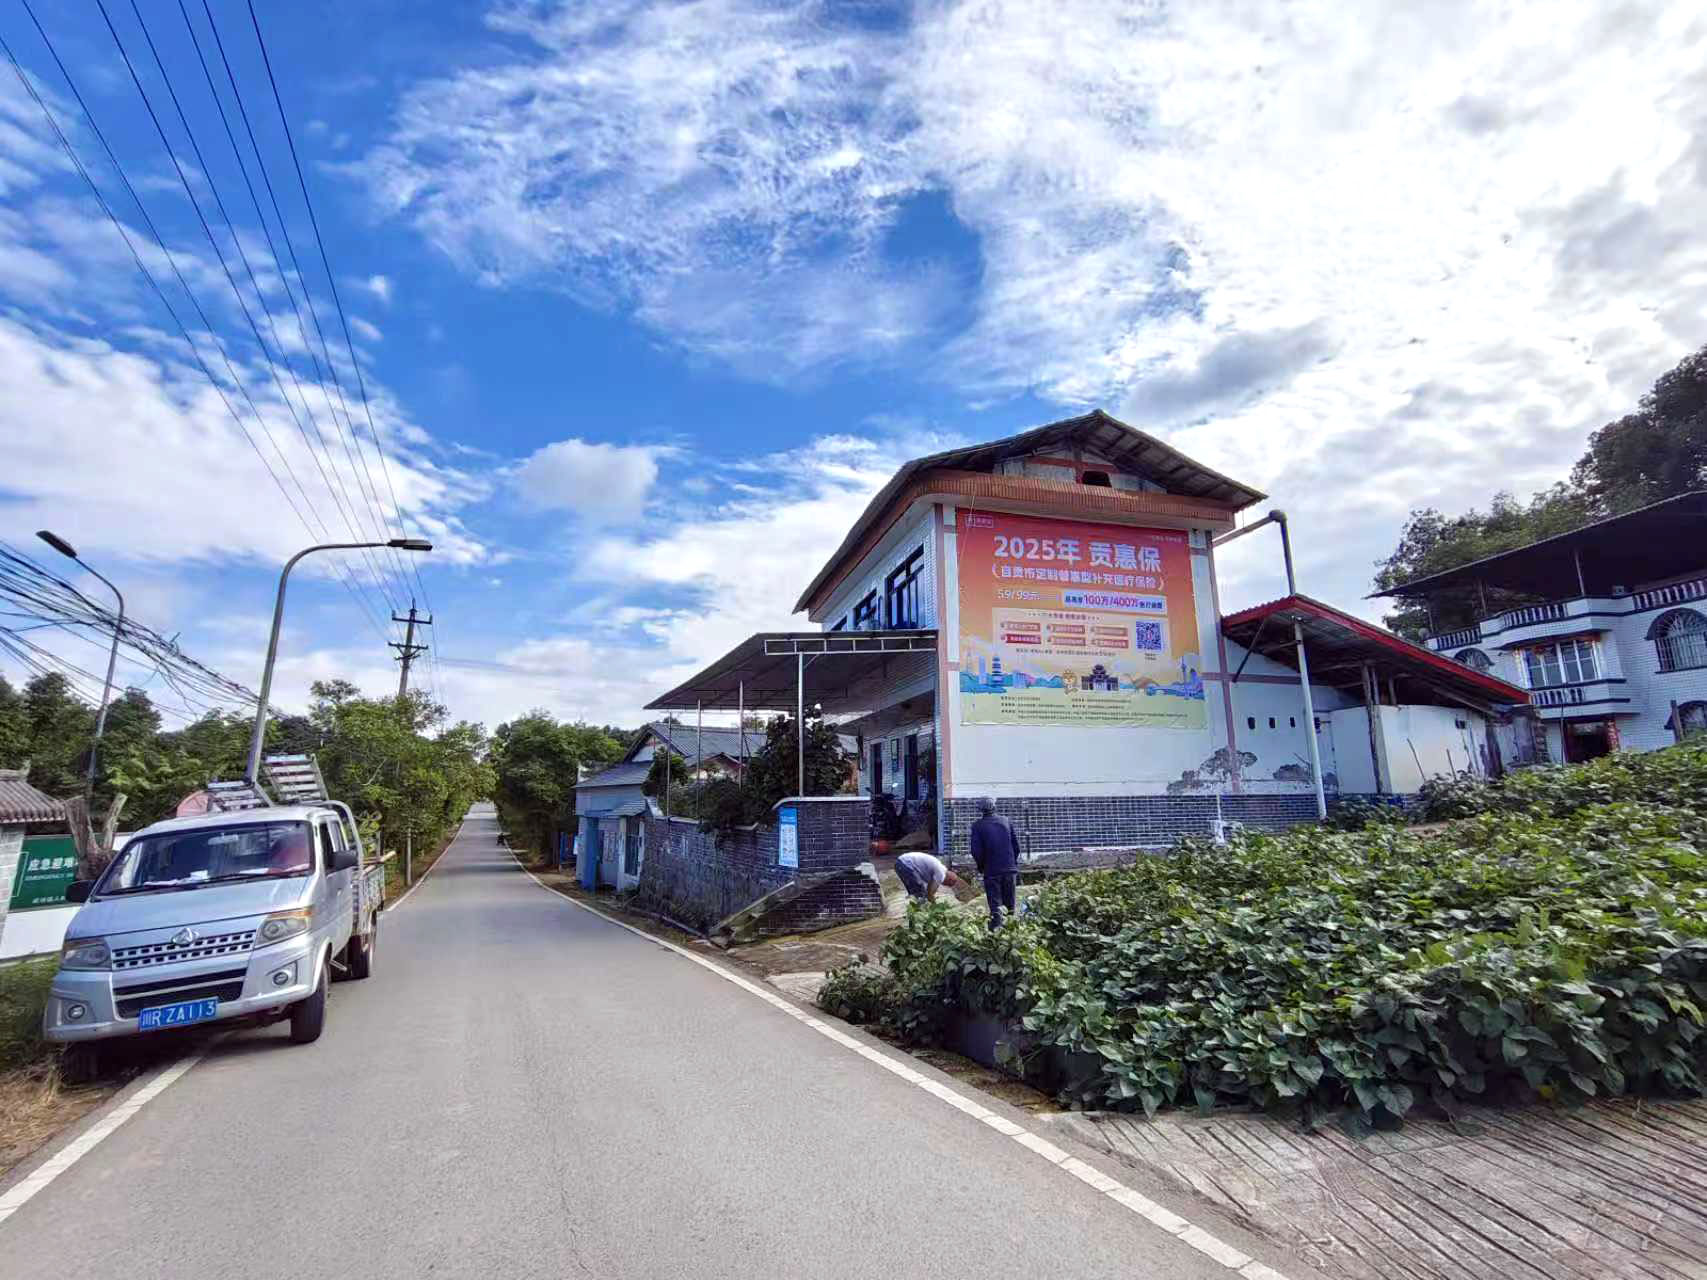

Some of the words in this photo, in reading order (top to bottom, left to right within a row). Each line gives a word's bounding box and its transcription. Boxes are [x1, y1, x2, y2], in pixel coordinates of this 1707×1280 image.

[993, 535, 1082, 566] 2025年
[1088, 541, 1162, 572] 贡惠保
